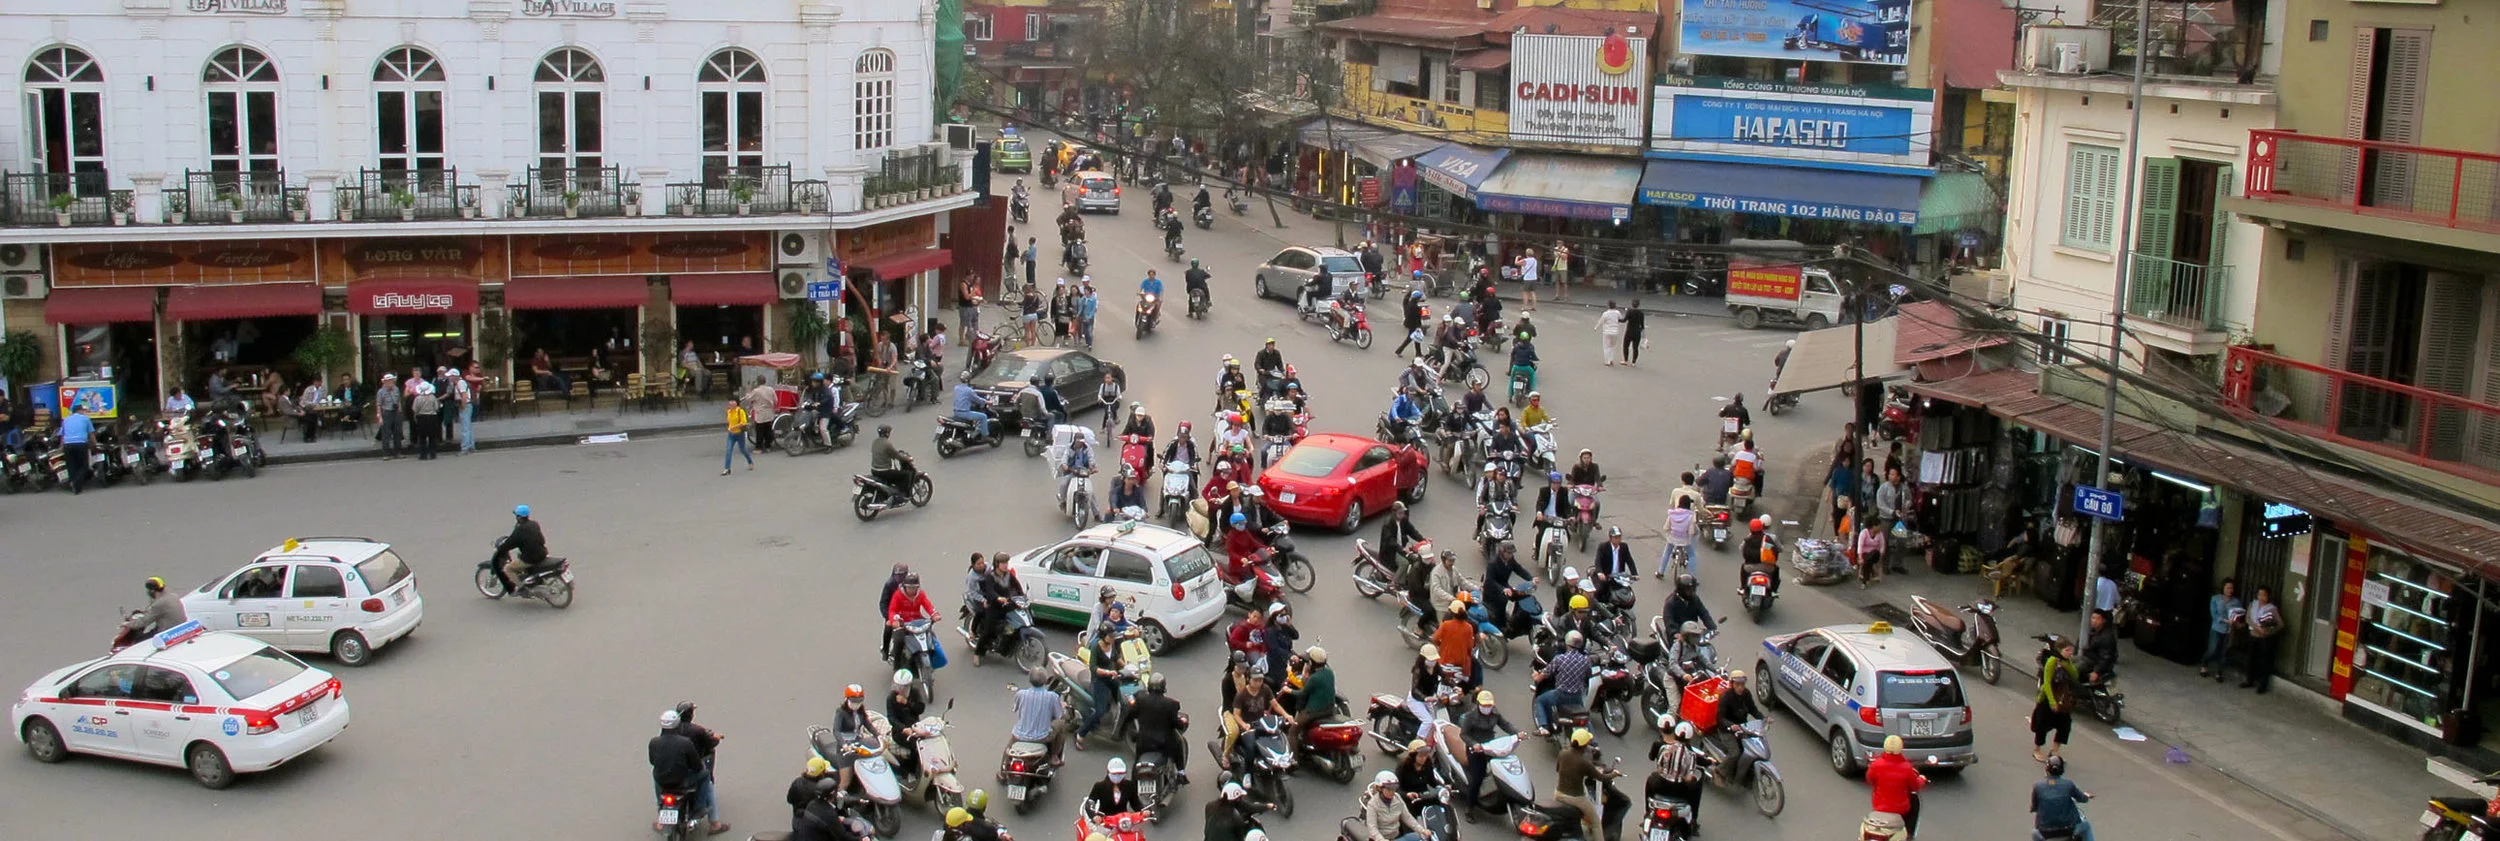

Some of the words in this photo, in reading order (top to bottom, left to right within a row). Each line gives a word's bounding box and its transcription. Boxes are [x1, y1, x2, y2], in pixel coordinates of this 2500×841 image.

[1775, 84, 1784, 92] TY
[1733, 115, 1848, 148] HAFASCO
[1438, 155, 1479, 179] VISA
[1646, 190, 1696, 202] HAFASCO
[1740, 200, 1787, 215] TRANG
[1792, 205, 1818, 217] 102
[1821, 206, 1861, 221] HÀNG
[1865, 208, 1895, 223] ĐÀO
[364, 250, 413, 262] LONG
